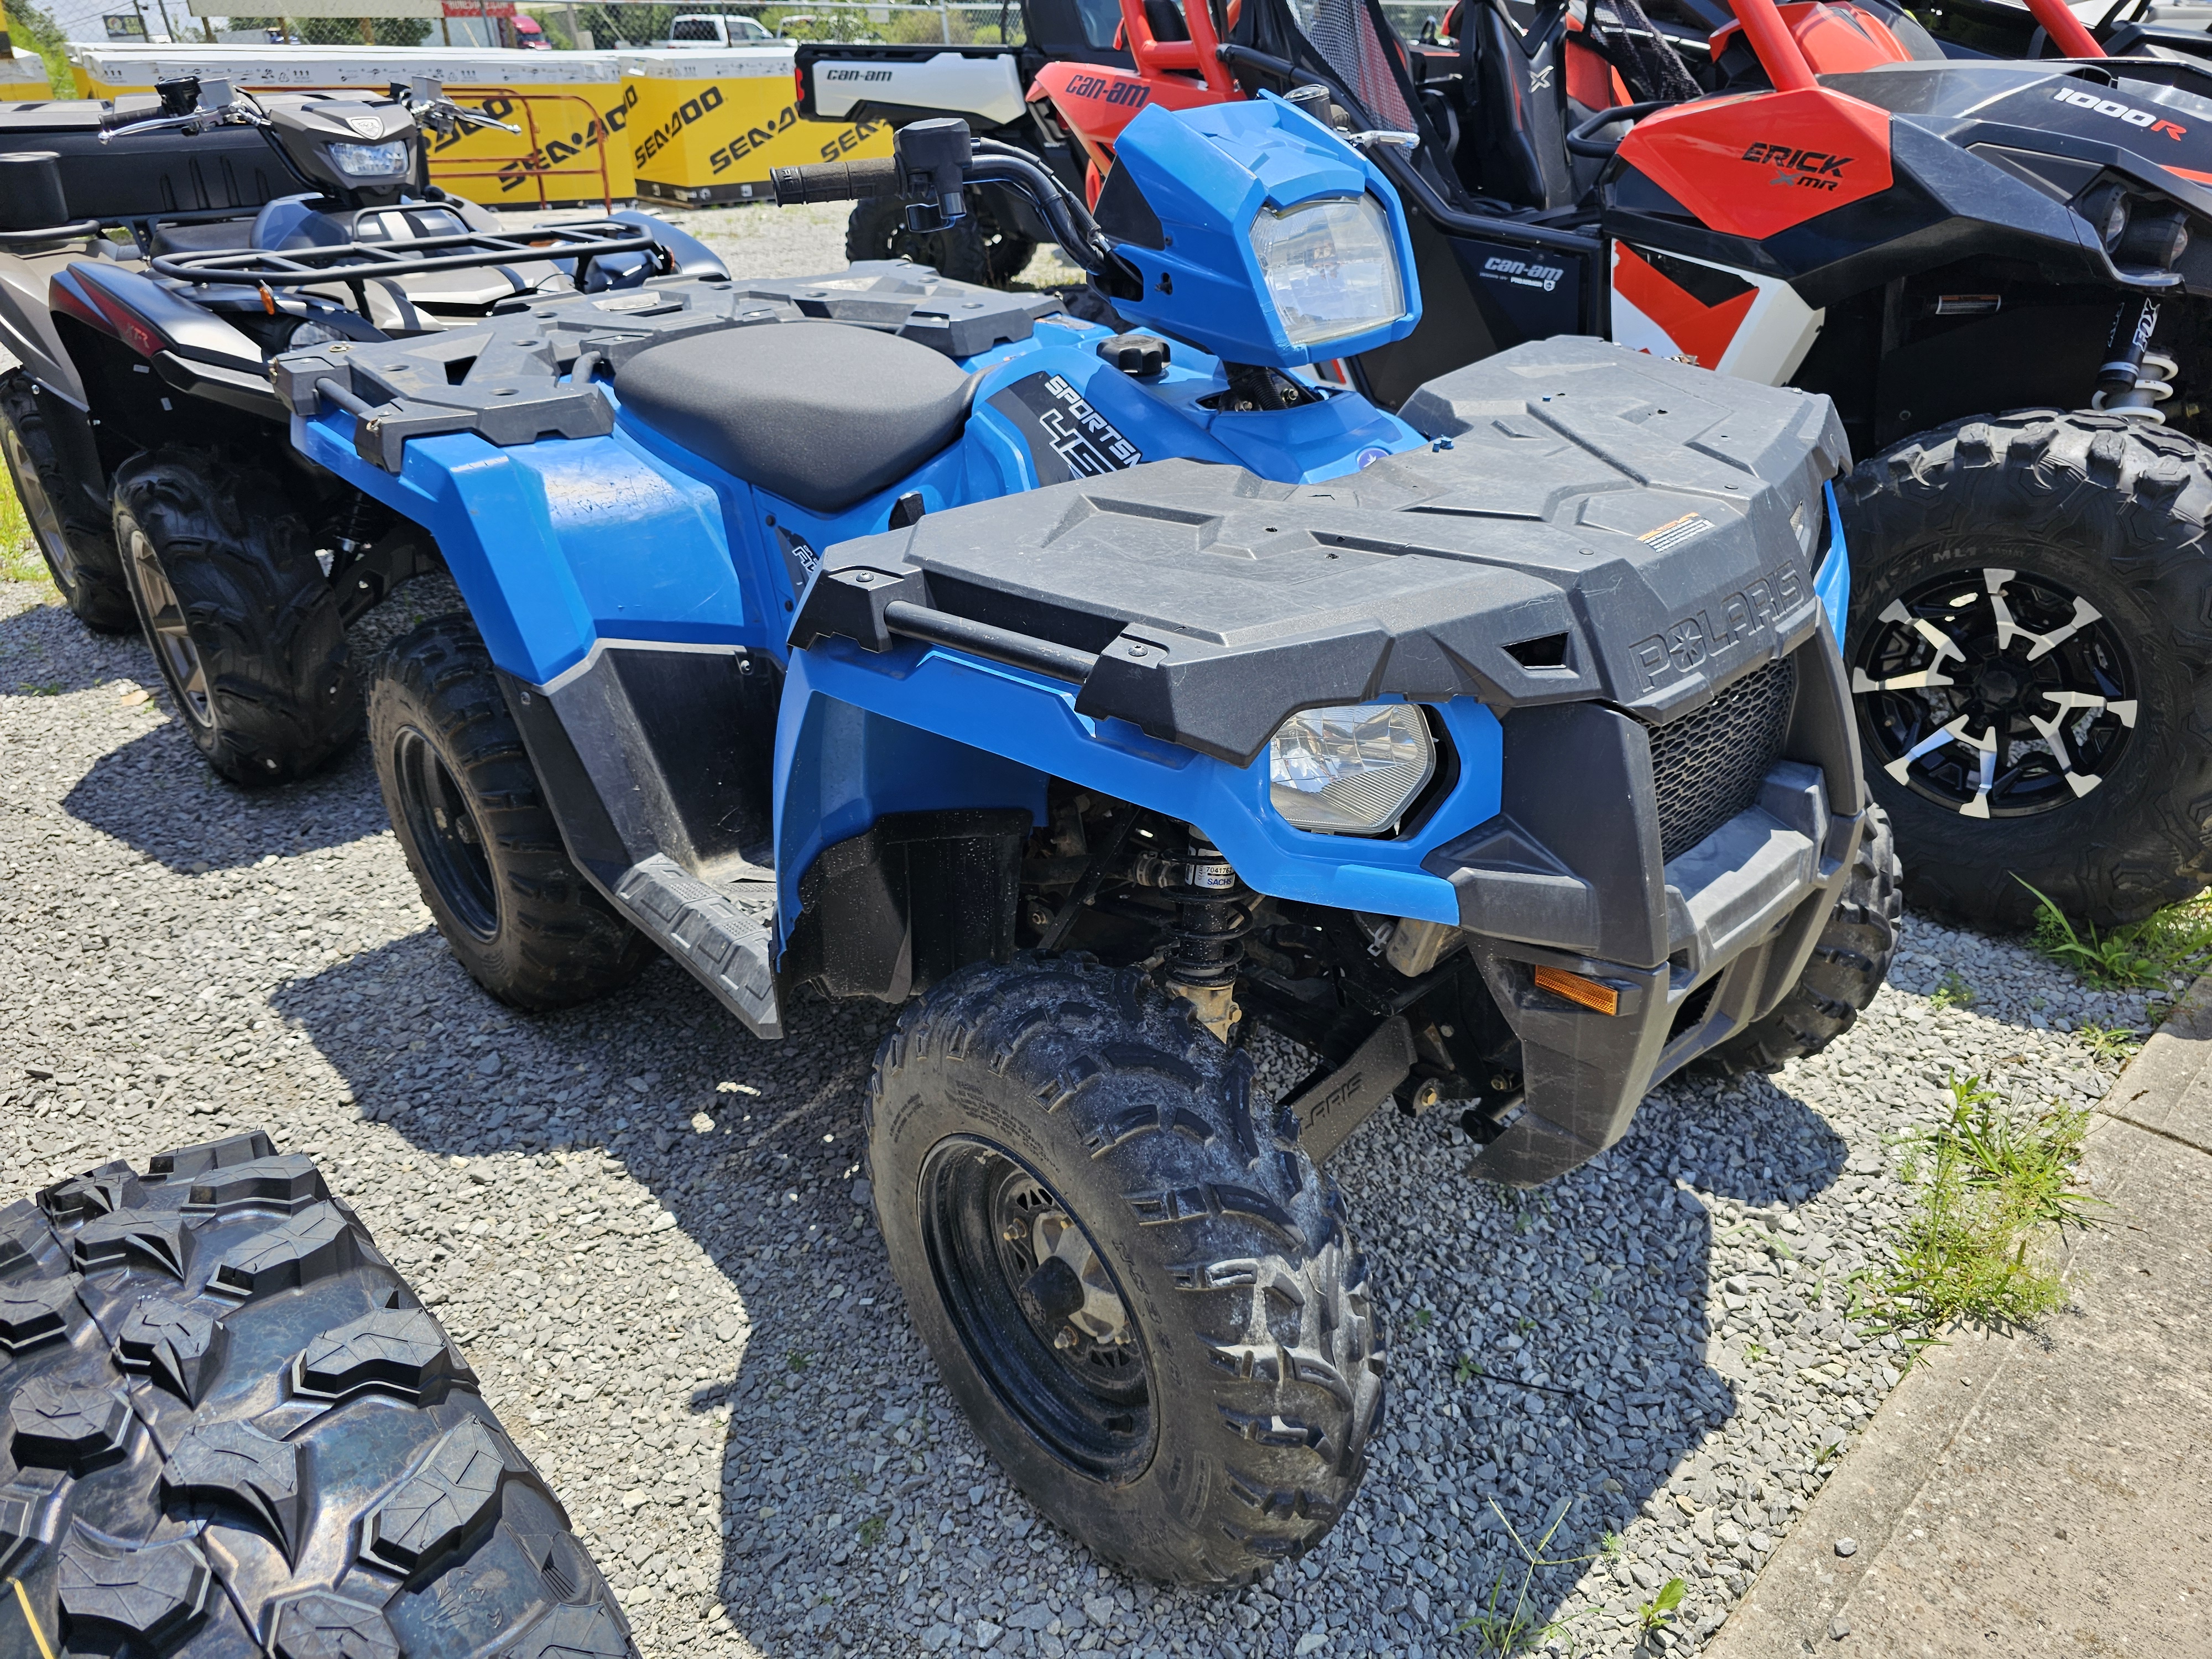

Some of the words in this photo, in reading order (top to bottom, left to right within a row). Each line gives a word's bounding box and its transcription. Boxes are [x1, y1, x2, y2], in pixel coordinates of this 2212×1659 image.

[827, 69, 893, 82] can-am
[1065, 74, 1151, 108] can-am
[2053, 87, 2187, 142] 1000R
[1484, 256, 1564, 281] can-am
[2132, 297, 2161, 353] FOX
[1045, 373, 1142, 468] SPORTS
[1628, 559, 1804, 693] POLARIS
[1207, 878, 1232, 886] SACHS
